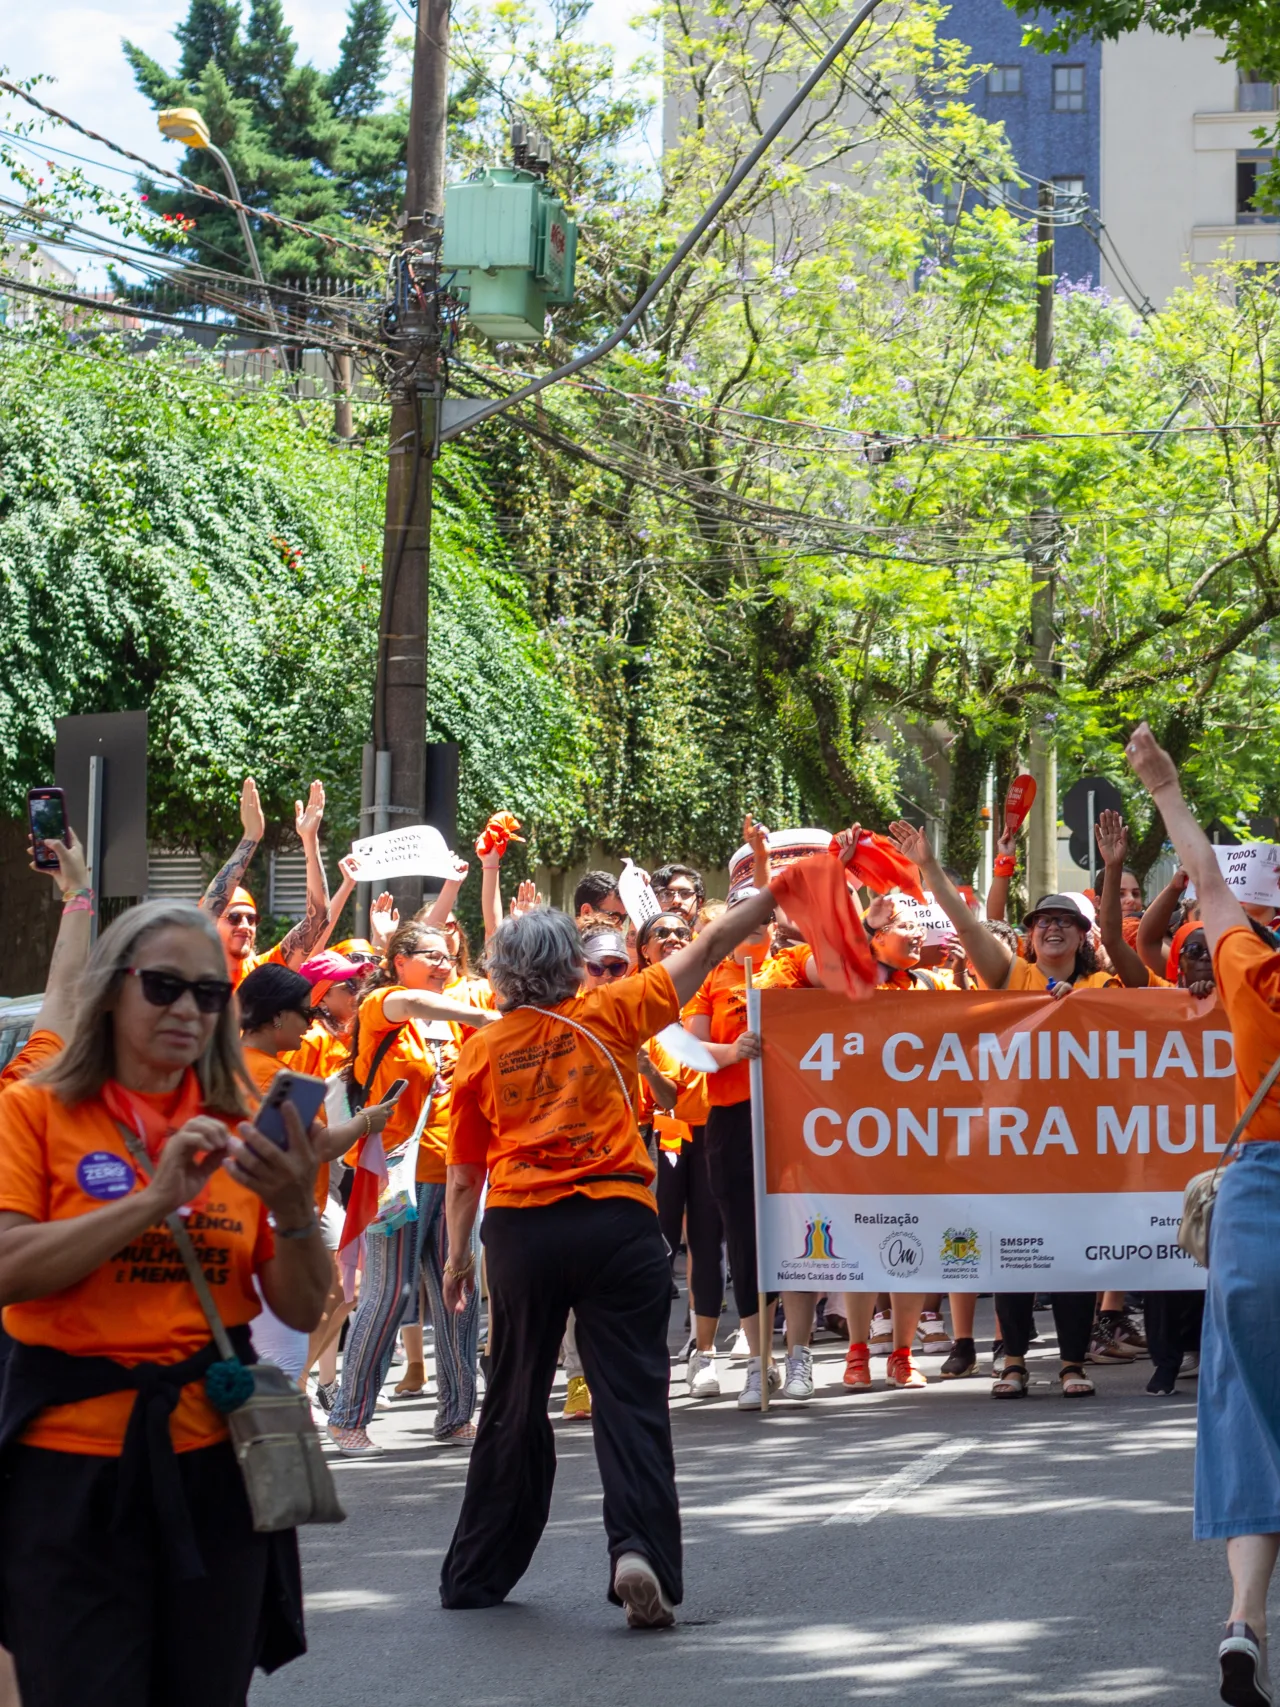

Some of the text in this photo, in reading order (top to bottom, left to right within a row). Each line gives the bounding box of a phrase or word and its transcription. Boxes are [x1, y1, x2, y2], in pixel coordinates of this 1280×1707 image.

[384, 843, 419, 854] CONTR
[1227, 849, 1257, 860] TODOS
[1229, 862, 1247, 873] POR
[1224, 876, 1247, 885] ELAS
[914, 909, 932, 918] 180
[799, 1032, 865, 1081] 4ª
[881, 1030, 1237, 1082] CAMINHAD
[802, 1106, 1079, 1158] CONTRA
[854, 1213, 919, 1227] Realização
[1150, 1216, 1183, 1227] Patro
[1000, 1237, 1044, 1246] SMSPPS
[1085, 1244, 1153, 1261] GRUPO
[781, 1260, 802, 1270] Grupo
[831, 1261, 840, 1269] do
[841, 1261, 859, 1269] Brasil
[777, 1271, 864, 1281] Núcleo Caxias do Sul
